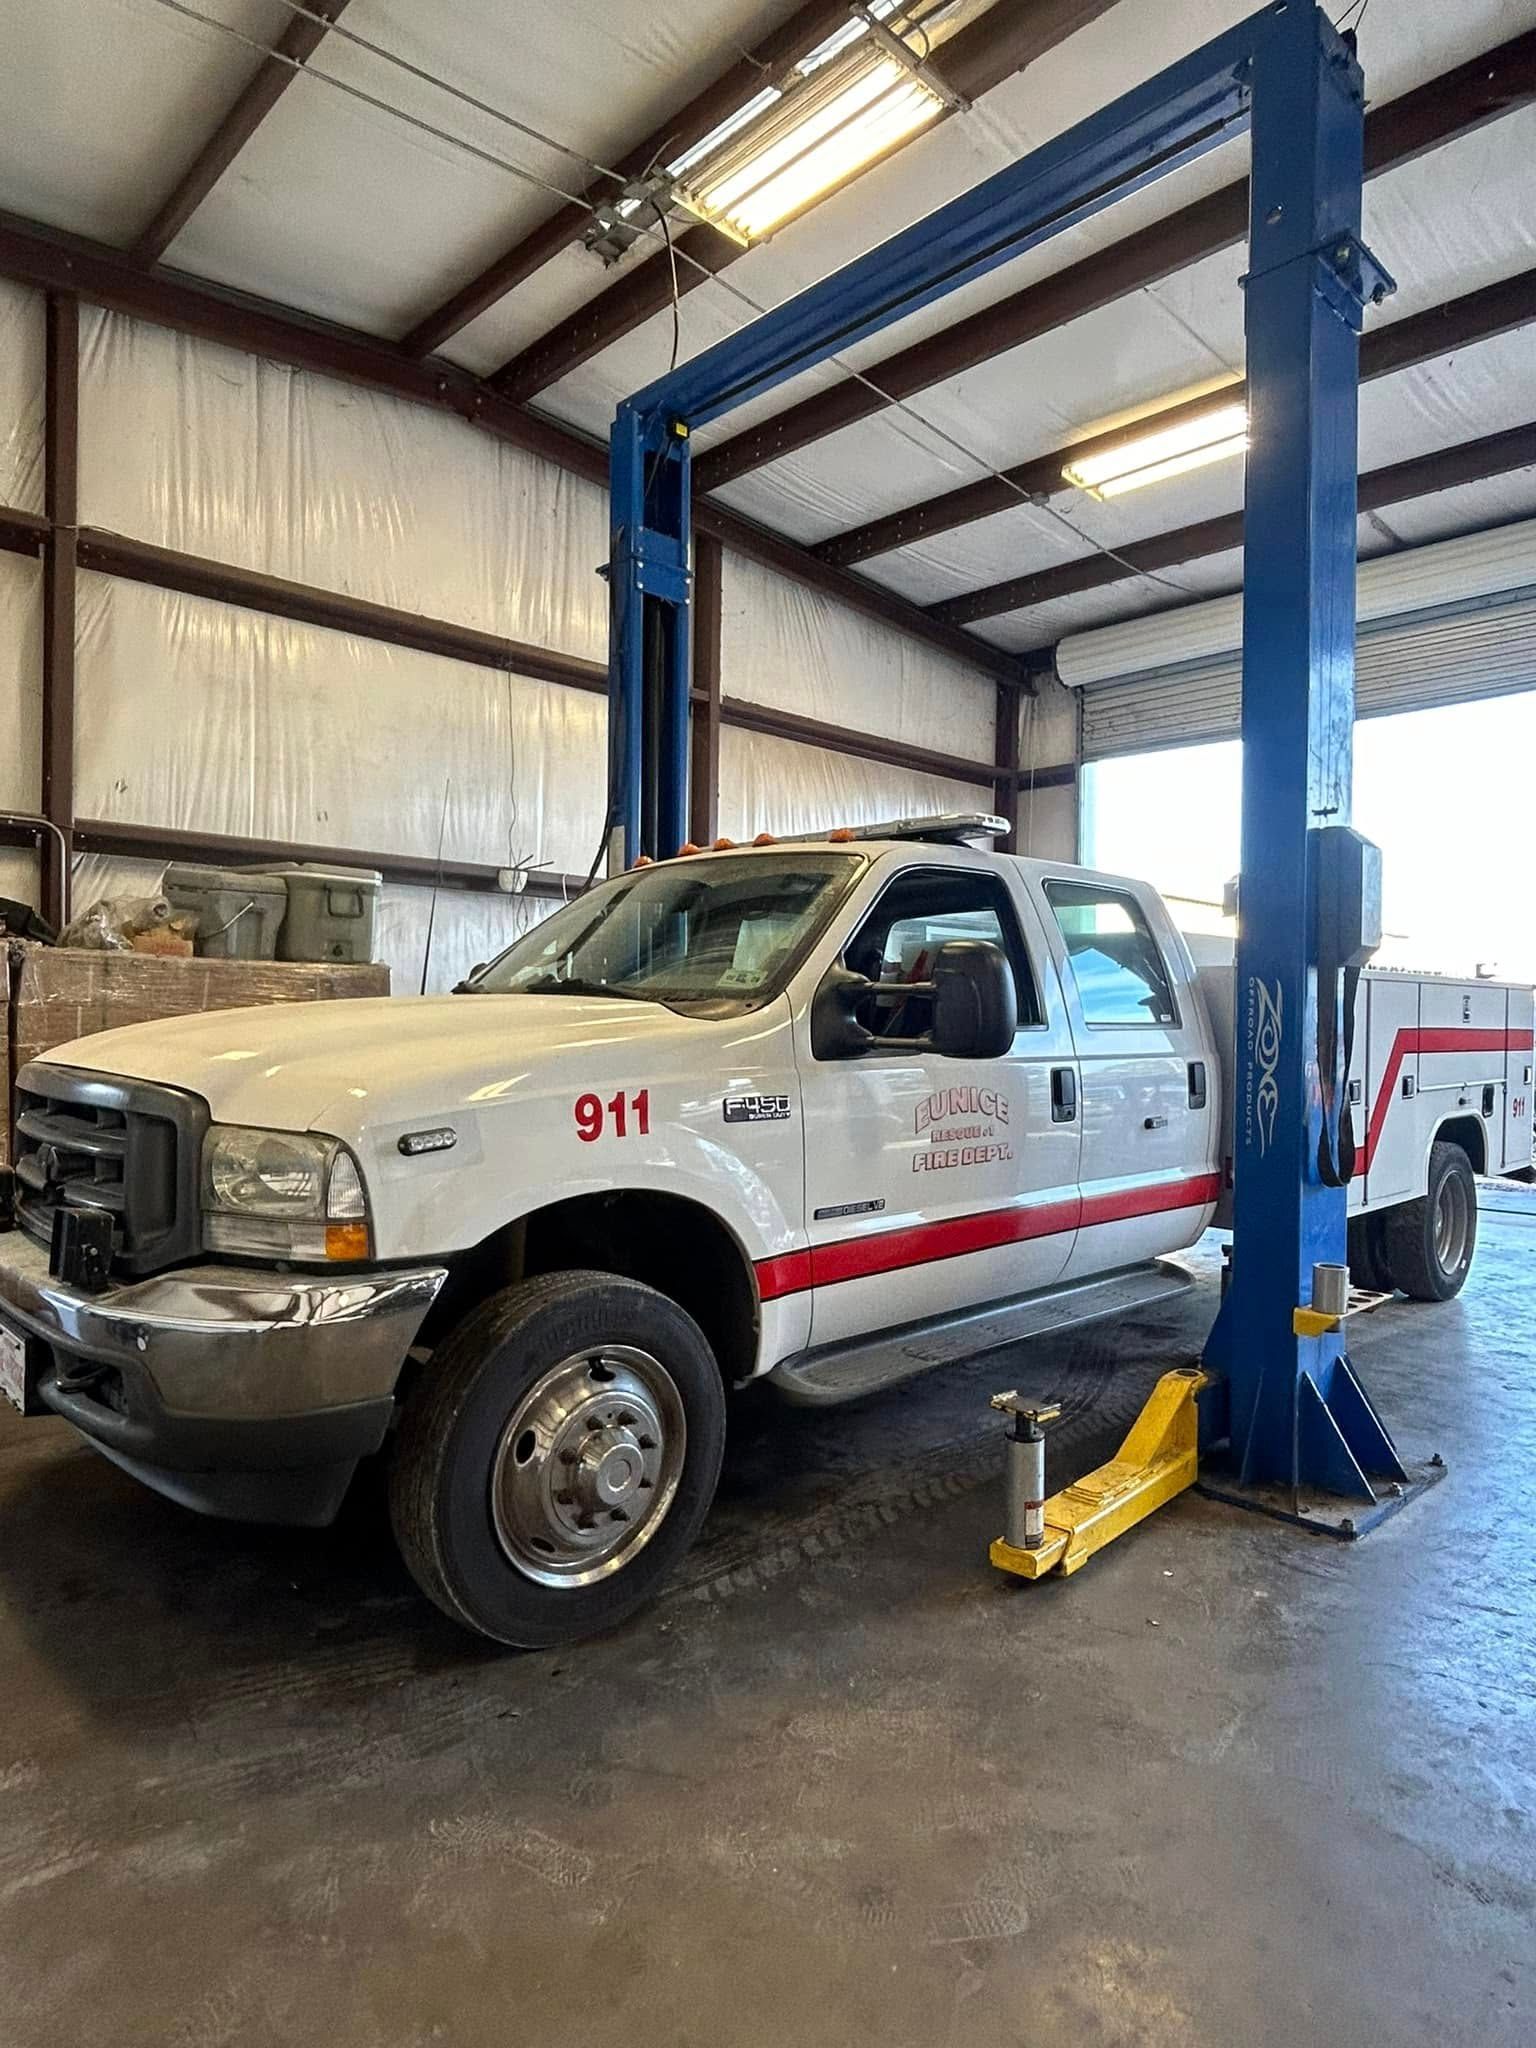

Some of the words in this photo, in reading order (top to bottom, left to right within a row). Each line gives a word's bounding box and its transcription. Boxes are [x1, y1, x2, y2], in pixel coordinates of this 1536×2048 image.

[1247, 976, 1255, 1051] OFFROAD
[574, 1088, 650, 1143] 911
[915, 1086, 1009, 1134] EUNICE
[1245, 1062, 1253, 1145] PRODUCTS
[1512, 1096, 1526, 1118] 911
[912, 1149, 960, 1172] FIRE
[961, 1143, 1013, 1166] DEPT.
[931, 1125, 981, 1143] RESCUE
